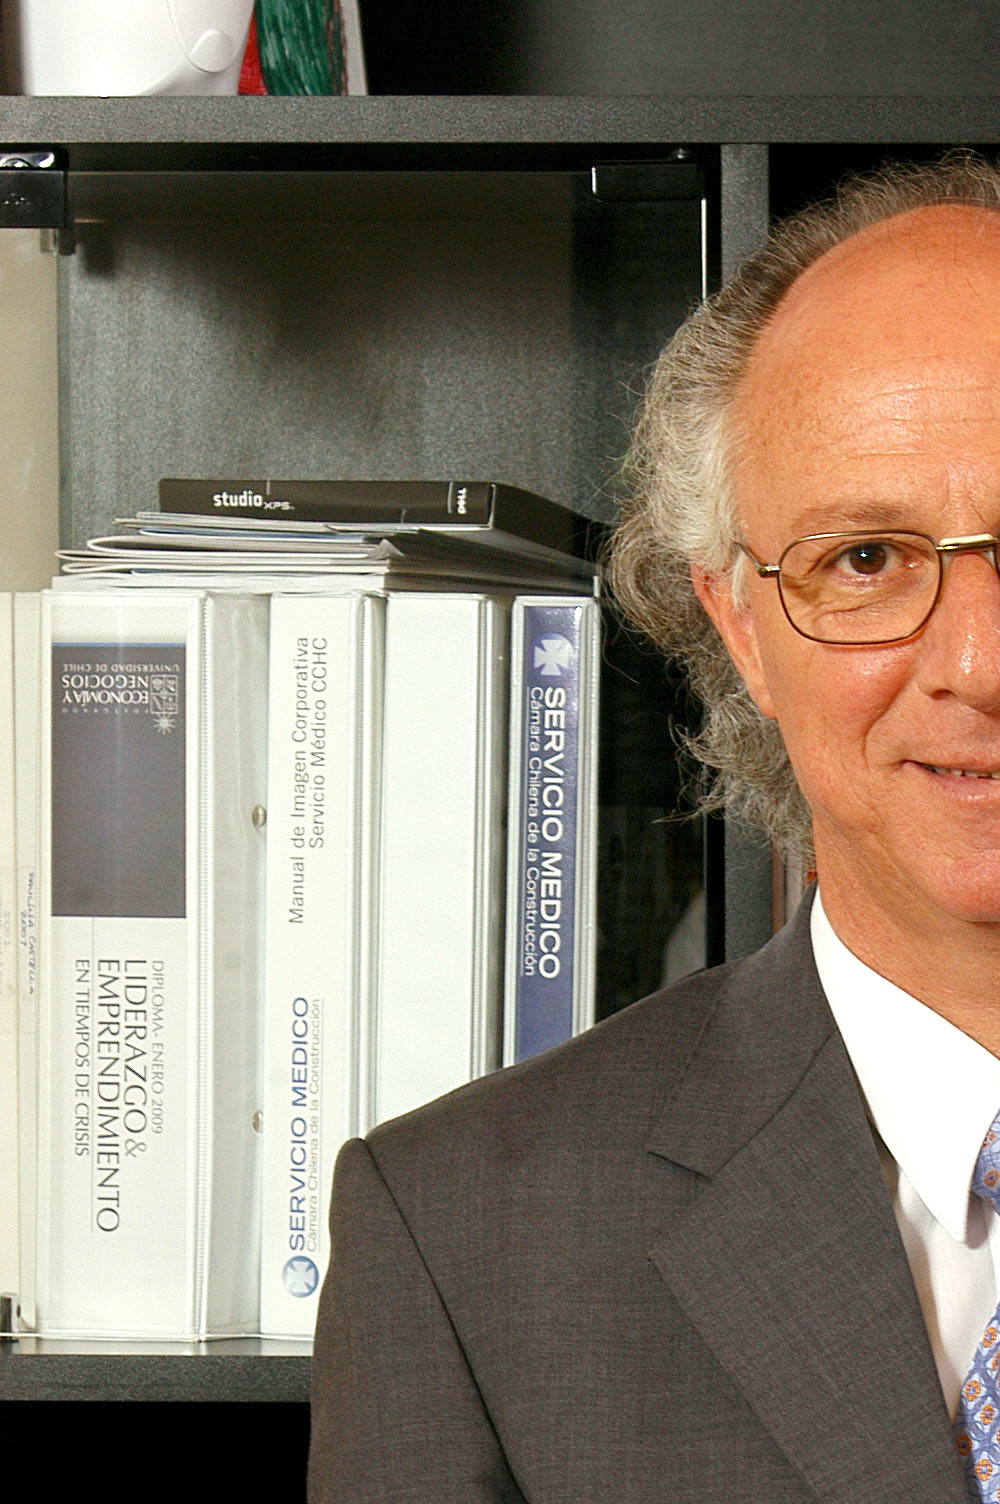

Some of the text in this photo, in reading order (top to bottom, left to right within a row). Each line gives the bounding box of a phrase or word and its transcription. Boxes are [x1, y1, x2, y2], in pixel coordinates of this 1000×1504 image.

[213, 490, 290, 511] studio XPS
[61, 675, 149, 688] NEGOCIOS
[62, 690, 149, 707] ECONOMÍA Y
[63, 663, 179, 672] UNIVERSIDAD DE CHILE
[309, 637, 328, 848] Servicio Médico CCHC
[289, 637, 311, 923] Manual de Imagen Corporativa
[524, 687, 543, 977] Cámara Chilena de la Construcción
[539, 687, 565, 979] SERVICIO MEDICO
[74, 959, 90, 1157] EN TIEMPOS DE CRISIS
[96, 959, 120, 1232] EMPRENDIMIENTO
[123, 960, 147, 1158] LIDERAZGO &
[151, 1042, 164, 1094] ENERO
[151, 1099, 163, 1135] 2009
[289, 997, 308, 1251] SERVICIO MEDICO
[307, 999, 320, 1252] Cámara Chilena de la Construcción
